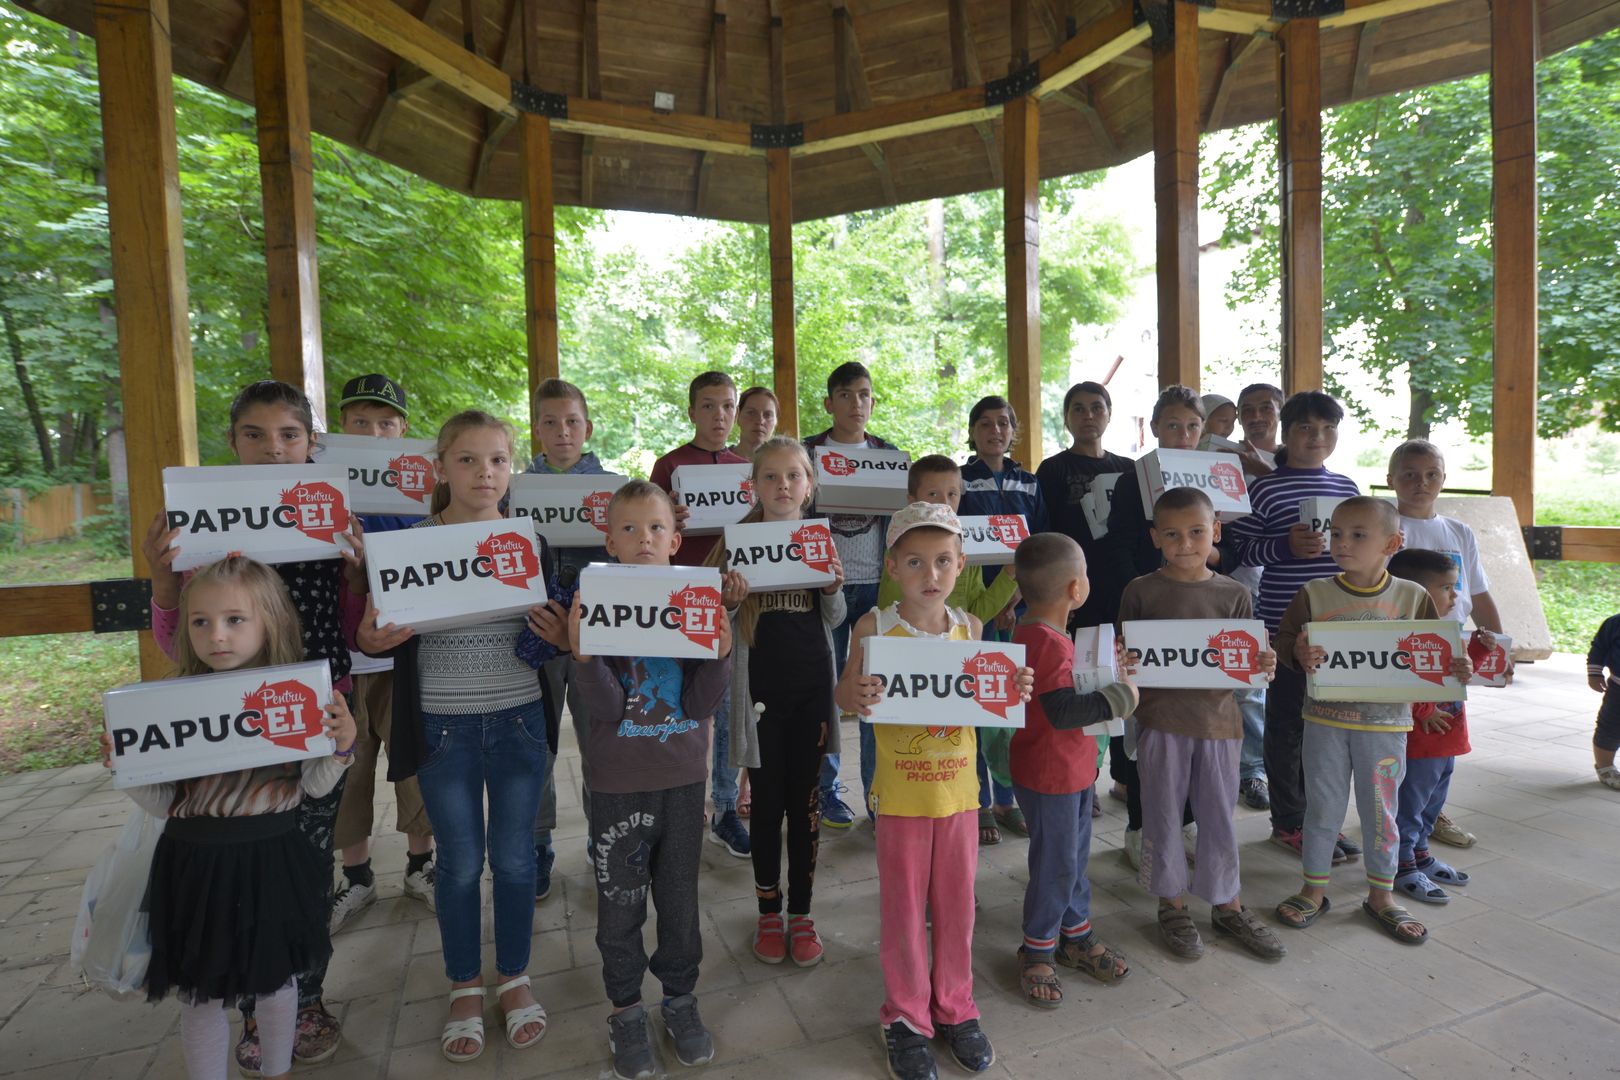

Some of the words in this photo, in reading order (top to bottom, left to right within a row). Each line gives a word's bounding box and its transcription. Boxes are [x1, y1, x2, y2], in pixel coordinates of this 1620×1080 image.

[293, 487, 335, 503] Pentru
[685, 490, 752, 507] PAPUC
[167, 503, 335, 534] PAPUCEI
[516, 507, 608, 524] PAPUCE
[800, 529, 828, 540] Pentru
[488, 538, 525, 552] Pentru
[380, 551, 527, 592] PAPUCEI
[681, 591, 719, 607] Pentru
[1217, 635, 1251, 648] Pentru
[1408, 637, 1443, 650] Pentru
[973, 657, 1010, 673] Pentru
[1316, 651, 1444, 671] APUCEI
[257, 689, 307, 706] Pentru
[112, 704, 307, 757] PAPUCEI
[895, 760, 932, 771] HONG
[938, 757, 968, 770] KONG
[907, 770, 959, 782] PHOOEY
